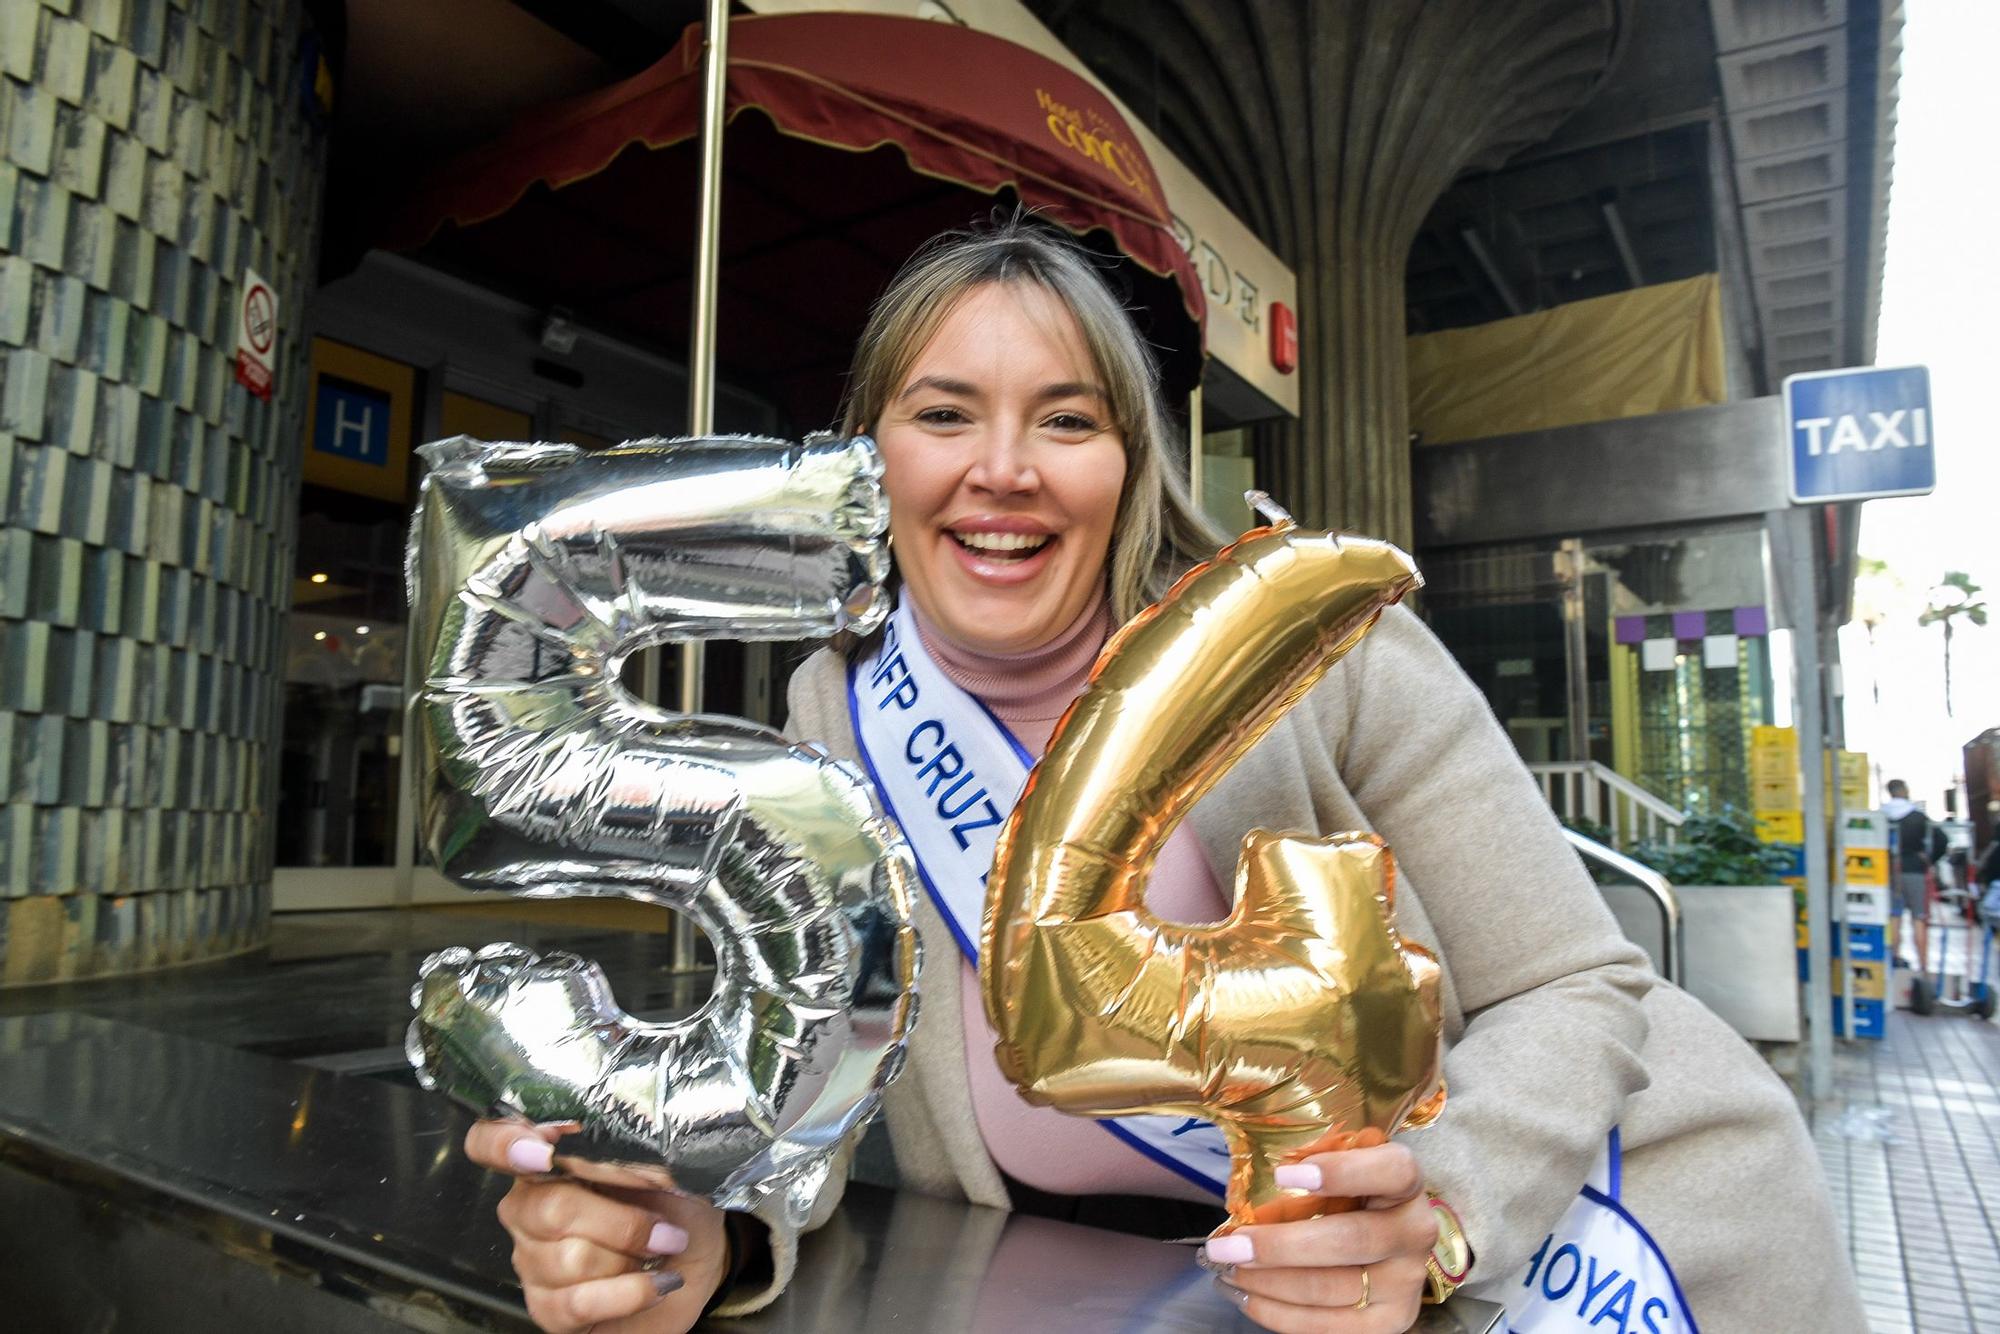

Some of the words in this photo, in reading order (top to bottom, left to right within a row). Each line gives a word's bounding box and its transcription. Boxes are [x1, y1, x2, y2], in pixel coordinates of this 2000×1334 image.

[333, 398, 371, 454] H
[1795, 407, 1927, 456] TAXI
[904, 718, 1004, 852] CRUZ
